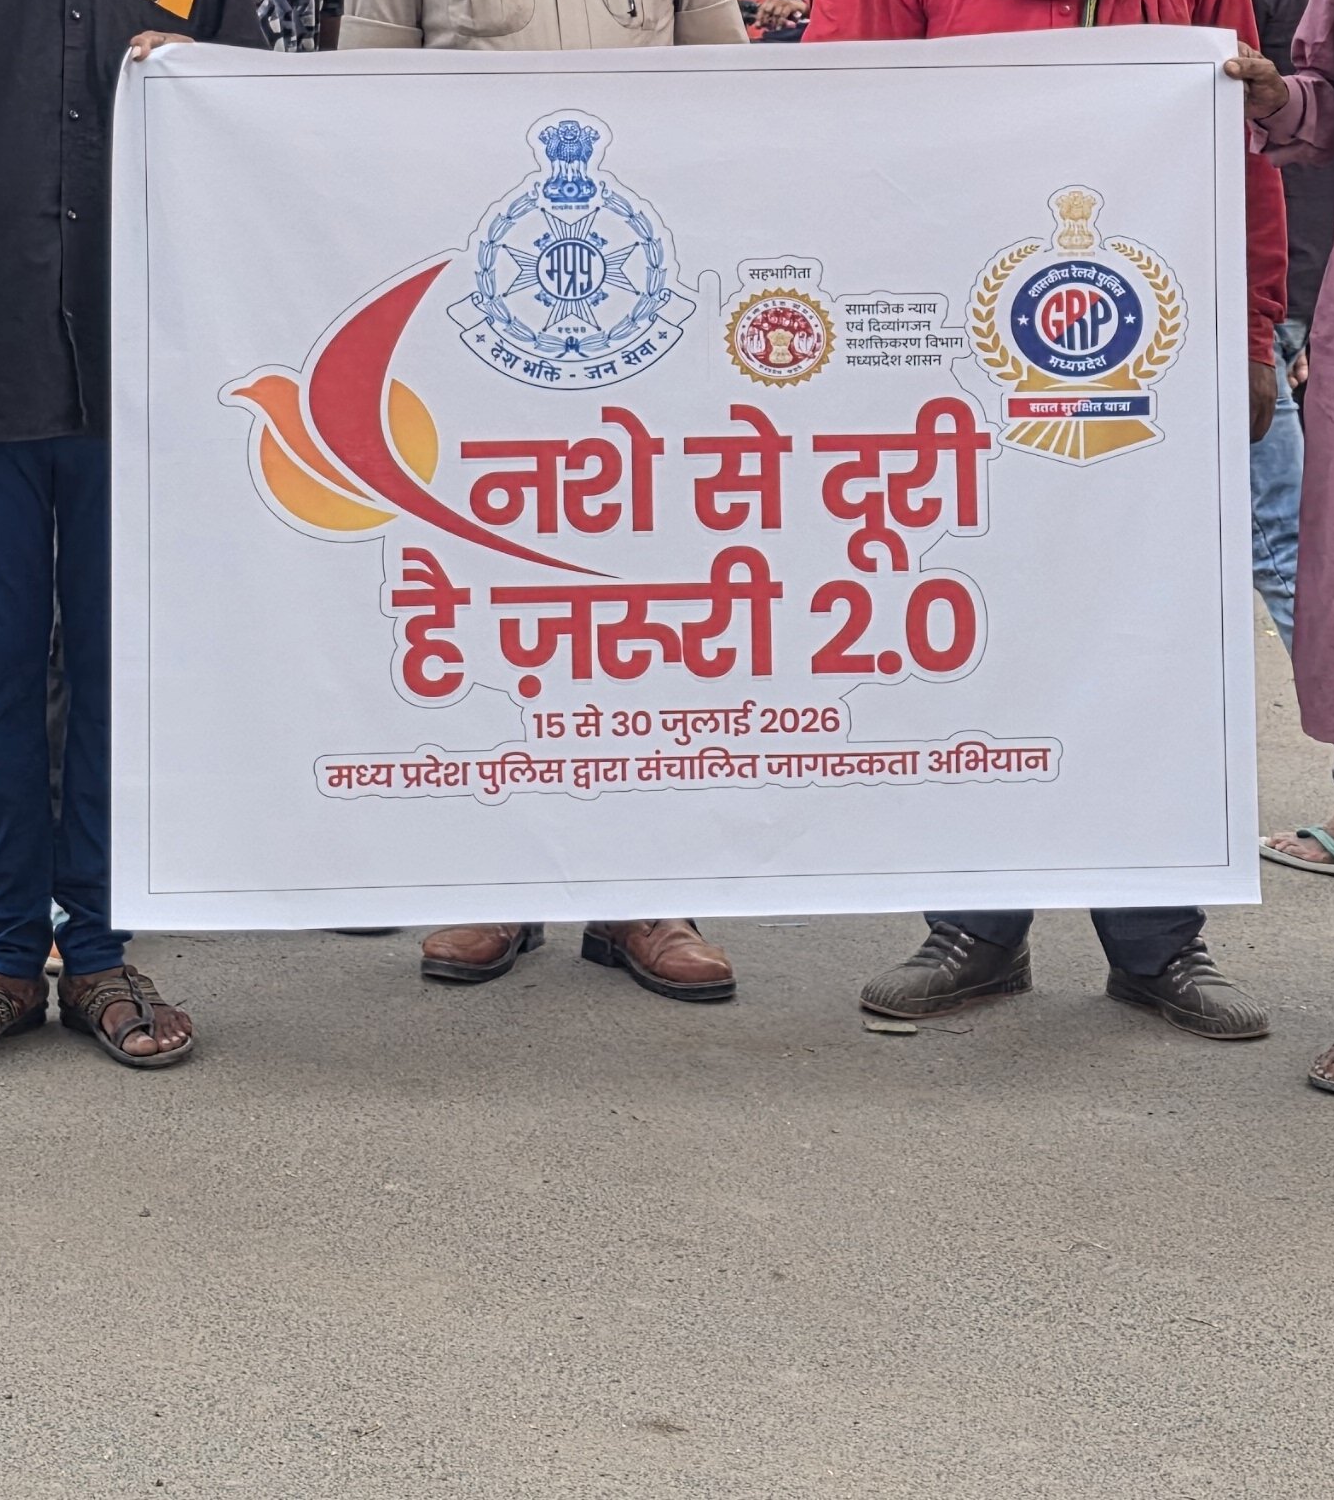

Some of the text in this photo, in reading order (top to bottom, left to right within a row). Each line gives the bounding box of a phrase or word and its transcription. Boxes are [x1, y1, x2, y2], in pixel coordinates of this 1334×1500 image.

[748, 265, 812, 281] सहभागिता
[1028, 264, 1127, 299] शासकीय रेलवे पुलिस
[845, 301, 937, 315] सामाजिक न्याय
[1041, 288, 1113, 351] GRP
[846, 318, 931, 333] एवं दिव्यांगजन
[846, 334, 963, 350] सशक्तिकरण विभाग
[490, 339, 522, 370] देश
[523, 359, 562, 382] भक्ति
[584, 360, 618, 380] जन
[621, 338, 657, 366] सेवा
[846, 352, 942, 367] मध्यप्रदेश शासन
[1048, 354, 1108, 372] मध्यप्रदेश
[1029, 399, 1132, 416] सतत सुरक्षित यात्रा
[460, 396, 992, 572] नशे से दूरी
[392, 545, 976, 698] है ज़रूरी 2.0
[533, 700, 841, 746] 15 से 30 जुलाई 2026
[325, 762, 396, 790] मध्य
[400, 754, 471, 790] प्रदेश
[476, 751, 566, 794] पुलिस
[571, 756, 630, 789] द्वारा
[635, 746, 760, 783] संचालित
[927, 741, 1052, 774] अभियान
